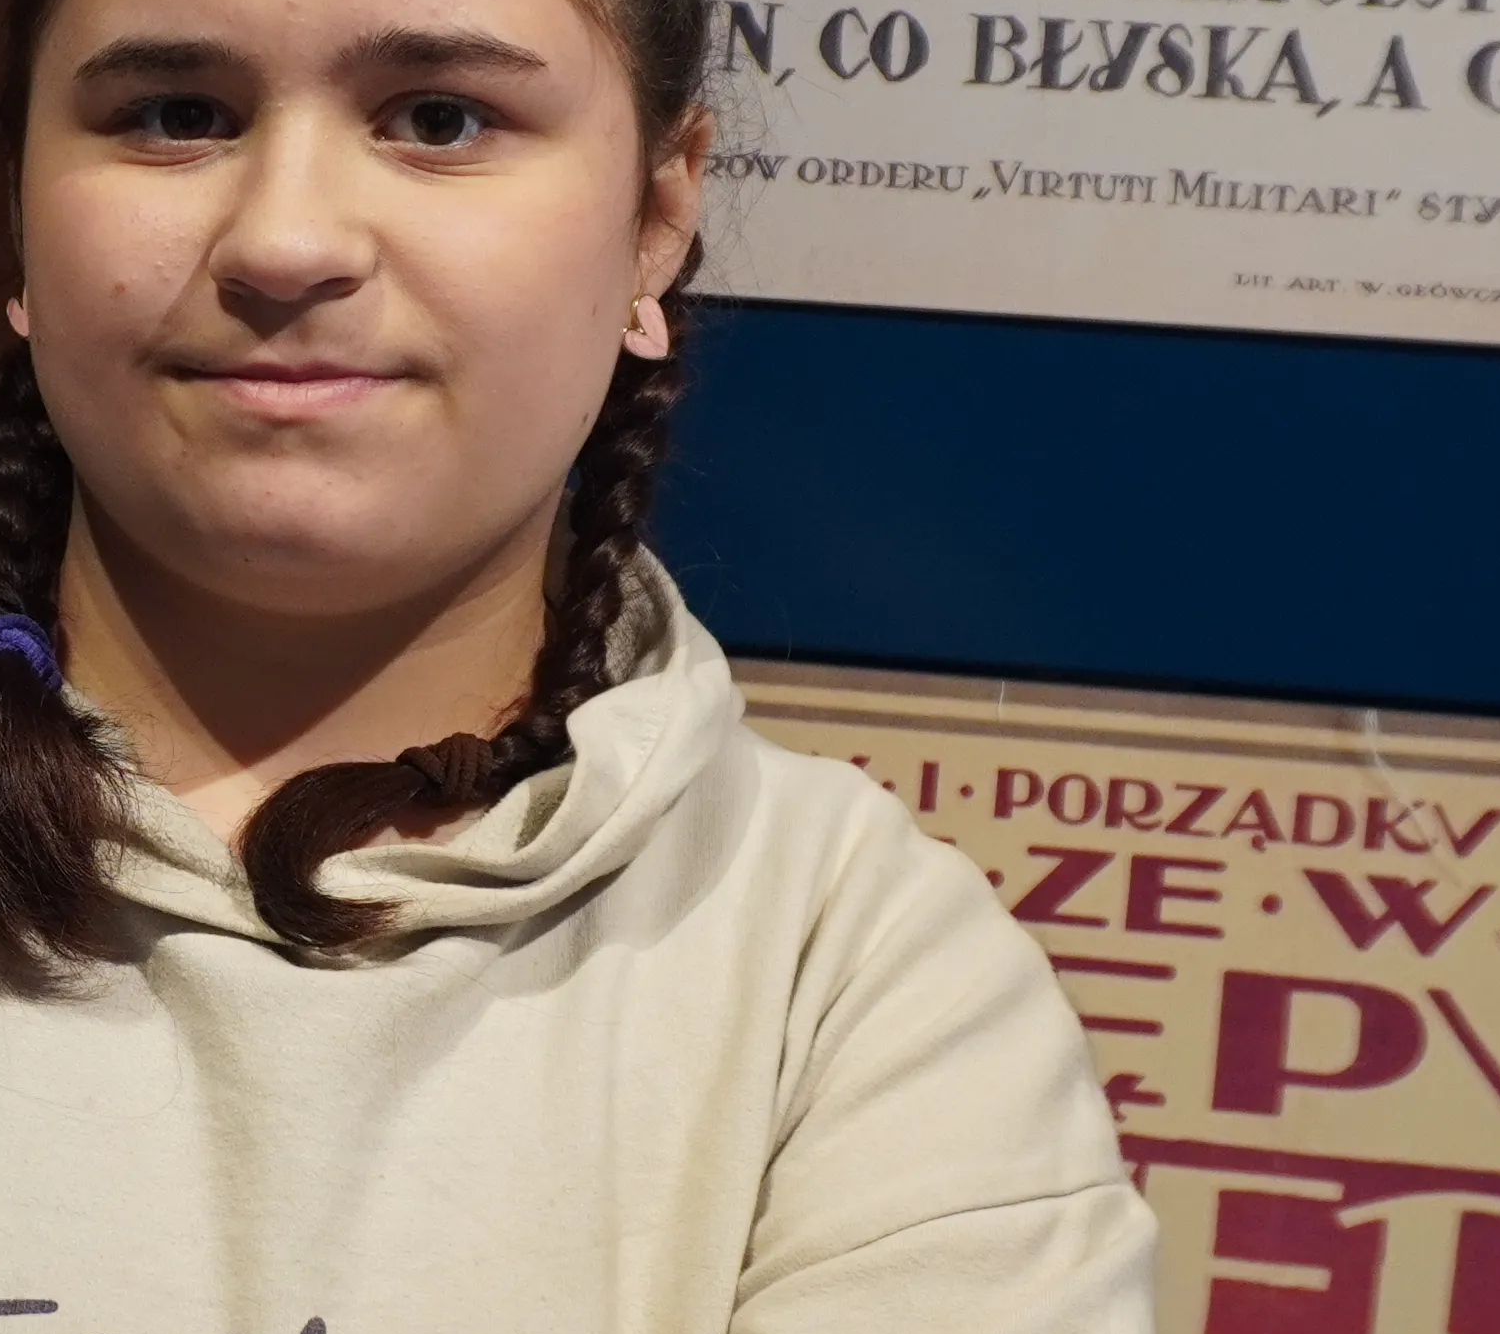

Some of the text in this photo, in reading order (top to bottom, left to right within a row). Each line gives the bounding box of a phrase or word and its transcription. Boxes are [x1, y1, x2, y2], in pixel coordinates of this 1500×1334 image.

[819, 6, 931, 82] CO
[1354, 34, 1432, 112] A
[702, 149, 791, 182] RÓW
[797, 156, 968, 194] ORDERU
[1008, 845, 1229, 939] ZE
